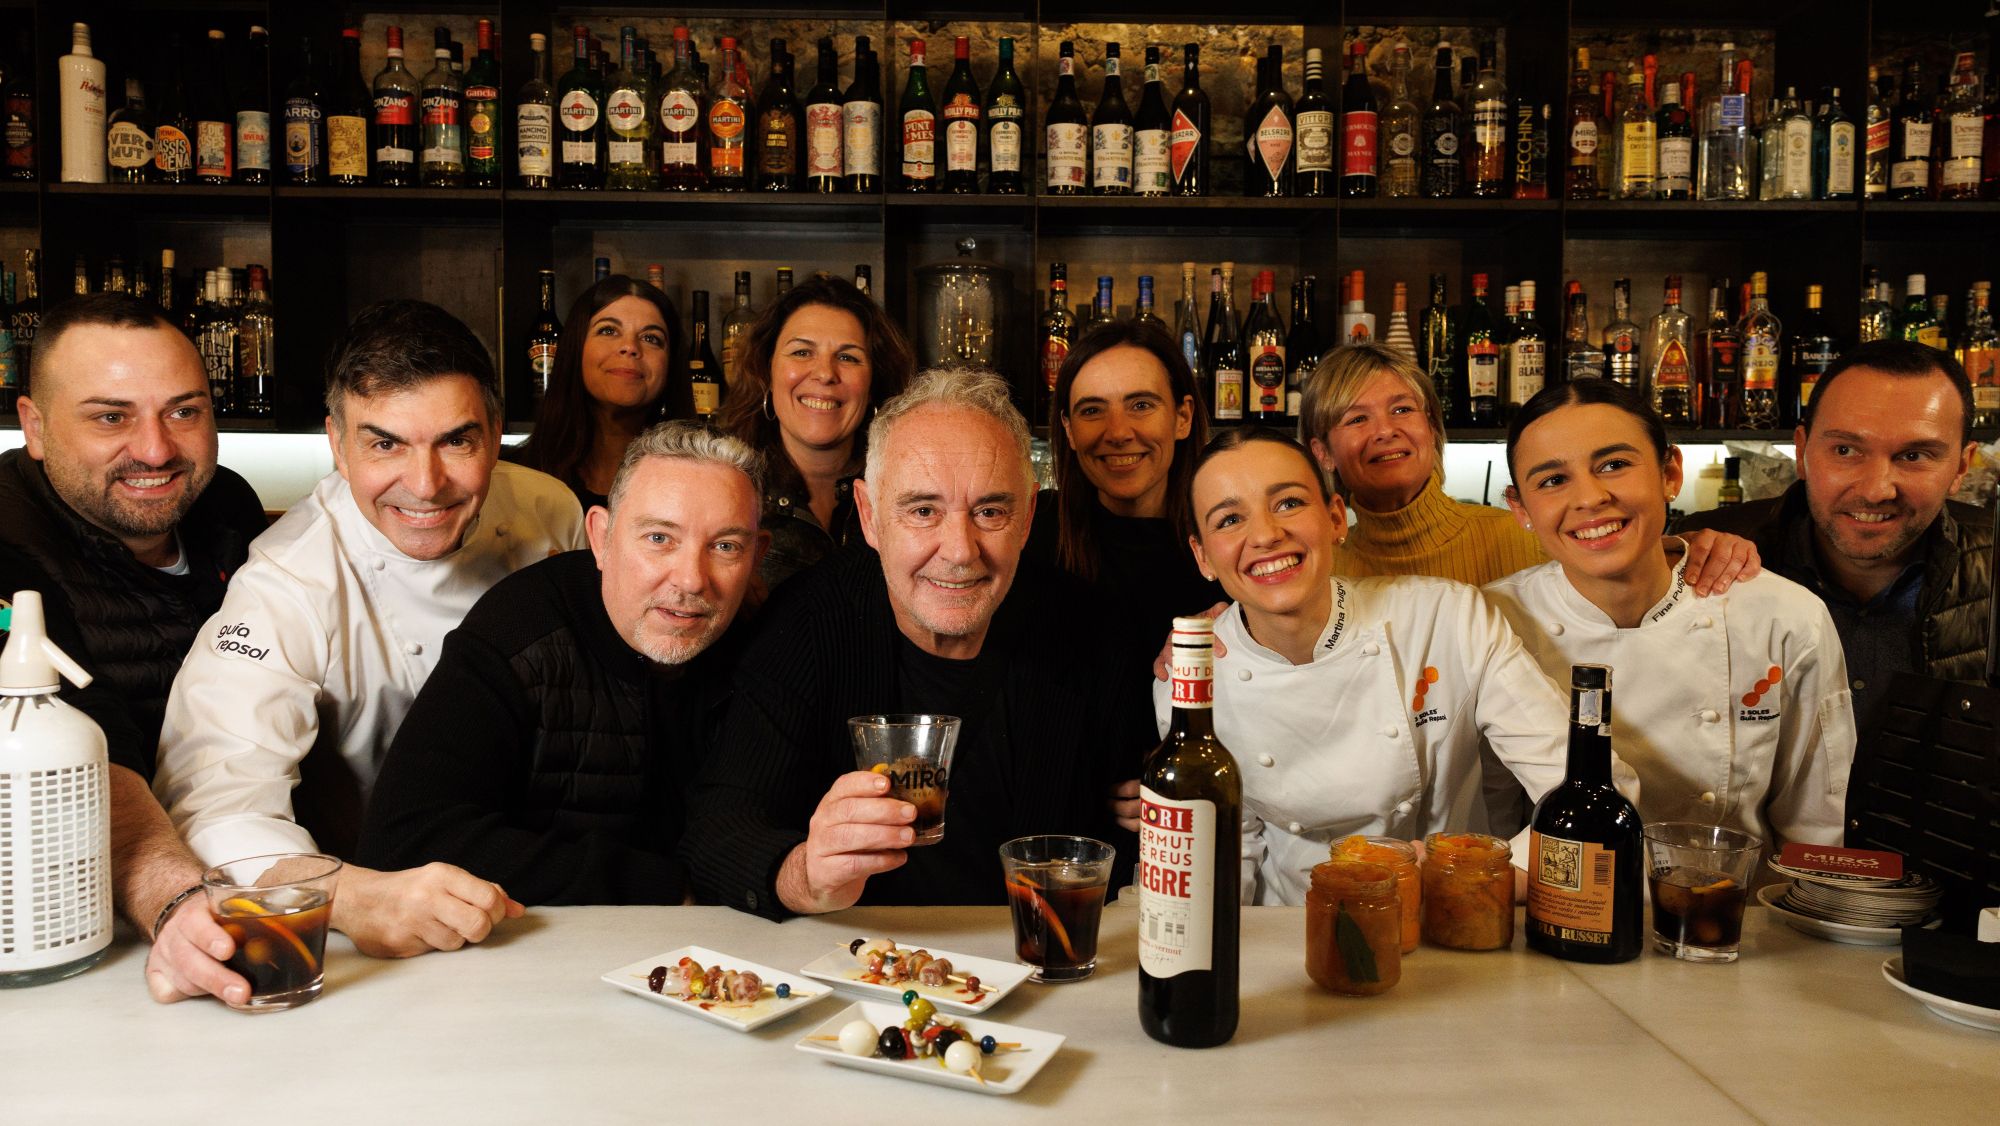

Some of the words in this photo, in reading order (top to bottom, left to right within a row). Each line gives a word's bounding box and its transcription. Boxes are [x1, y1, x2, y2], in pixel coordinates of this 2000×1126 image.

[373, 96, 409, 108] CINZANO
[422, 96, 459, 109] CINZANO
[562, 107, 595, 116] MARTINI
[609, 106, 641, 115] MARTINI
[663, 108, 695, 117] MARTINI
[712, 115, 741, 123] MARTINI
[904, 120, 931, 132] PUNT
[110, 132, 144, 147] VER
[911, 130, 935, 142] MES
[1515, 105, 1533, 183] ZECCHINI
[1652, 602, 1674, 623] Fina
[217, 622, 250, 638] guía
[1324, 611, 1345, 650] Martina
[215, 640, 270, 661] repsol
[1419, 708, 1438, 719] SOLES
[1141, 804, 1184, 830] CORI
[1140, 827, 1195, 851] ERMUT
[1150, 847, 1192, 867] REUS
[1560, 927, 1612, 945] RUSSET
